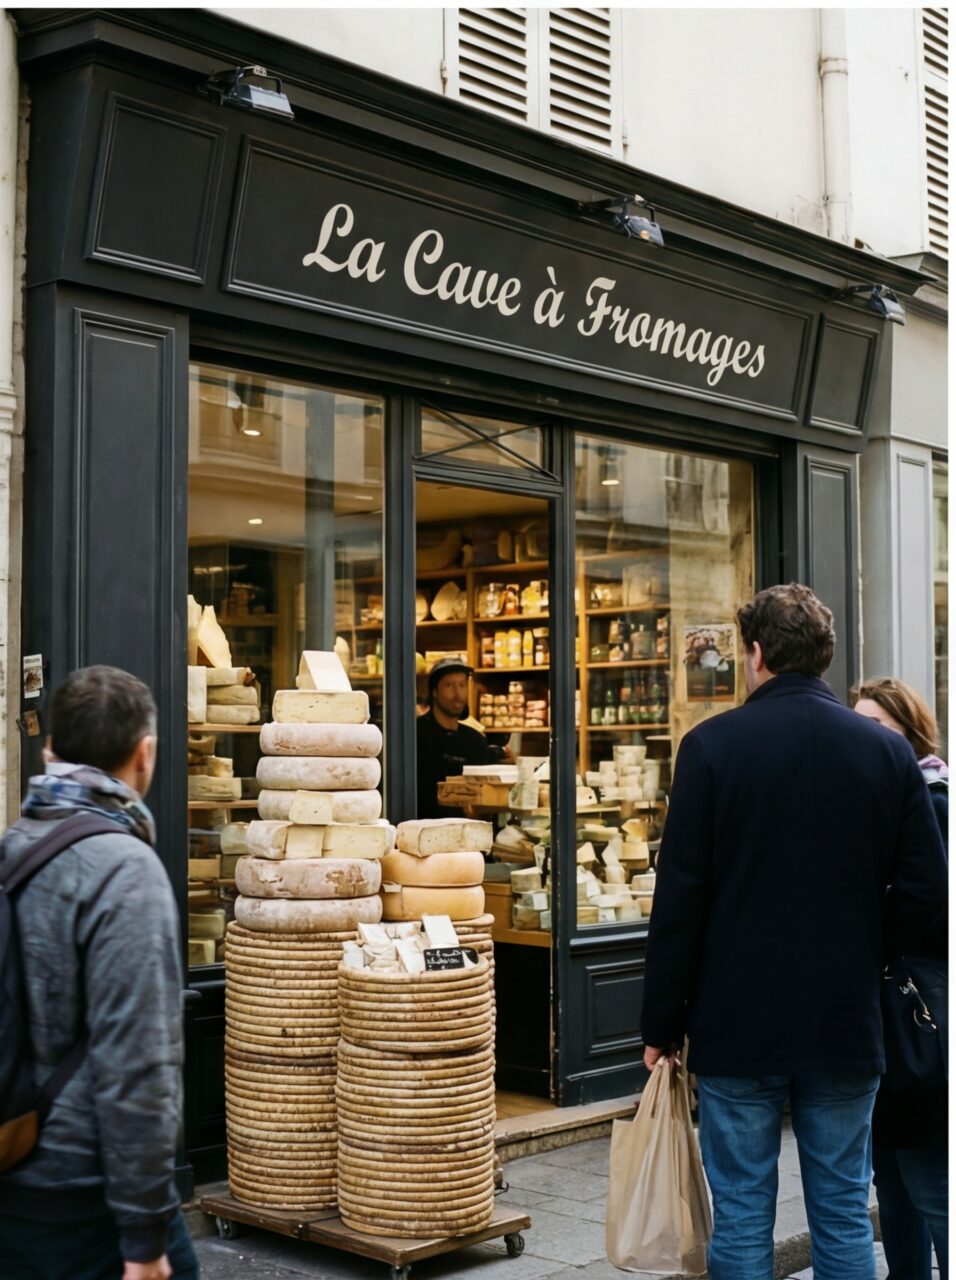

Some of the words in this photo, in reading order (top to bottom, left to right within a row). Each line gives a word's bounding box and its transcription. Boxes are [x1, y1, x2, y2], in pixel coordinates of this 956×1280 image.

[302, 203, 386, 283] La
[403, 229, 521, 316] Cave
[533, 266, 565, 328] à
[577, 276, 766, 387] Fromages
